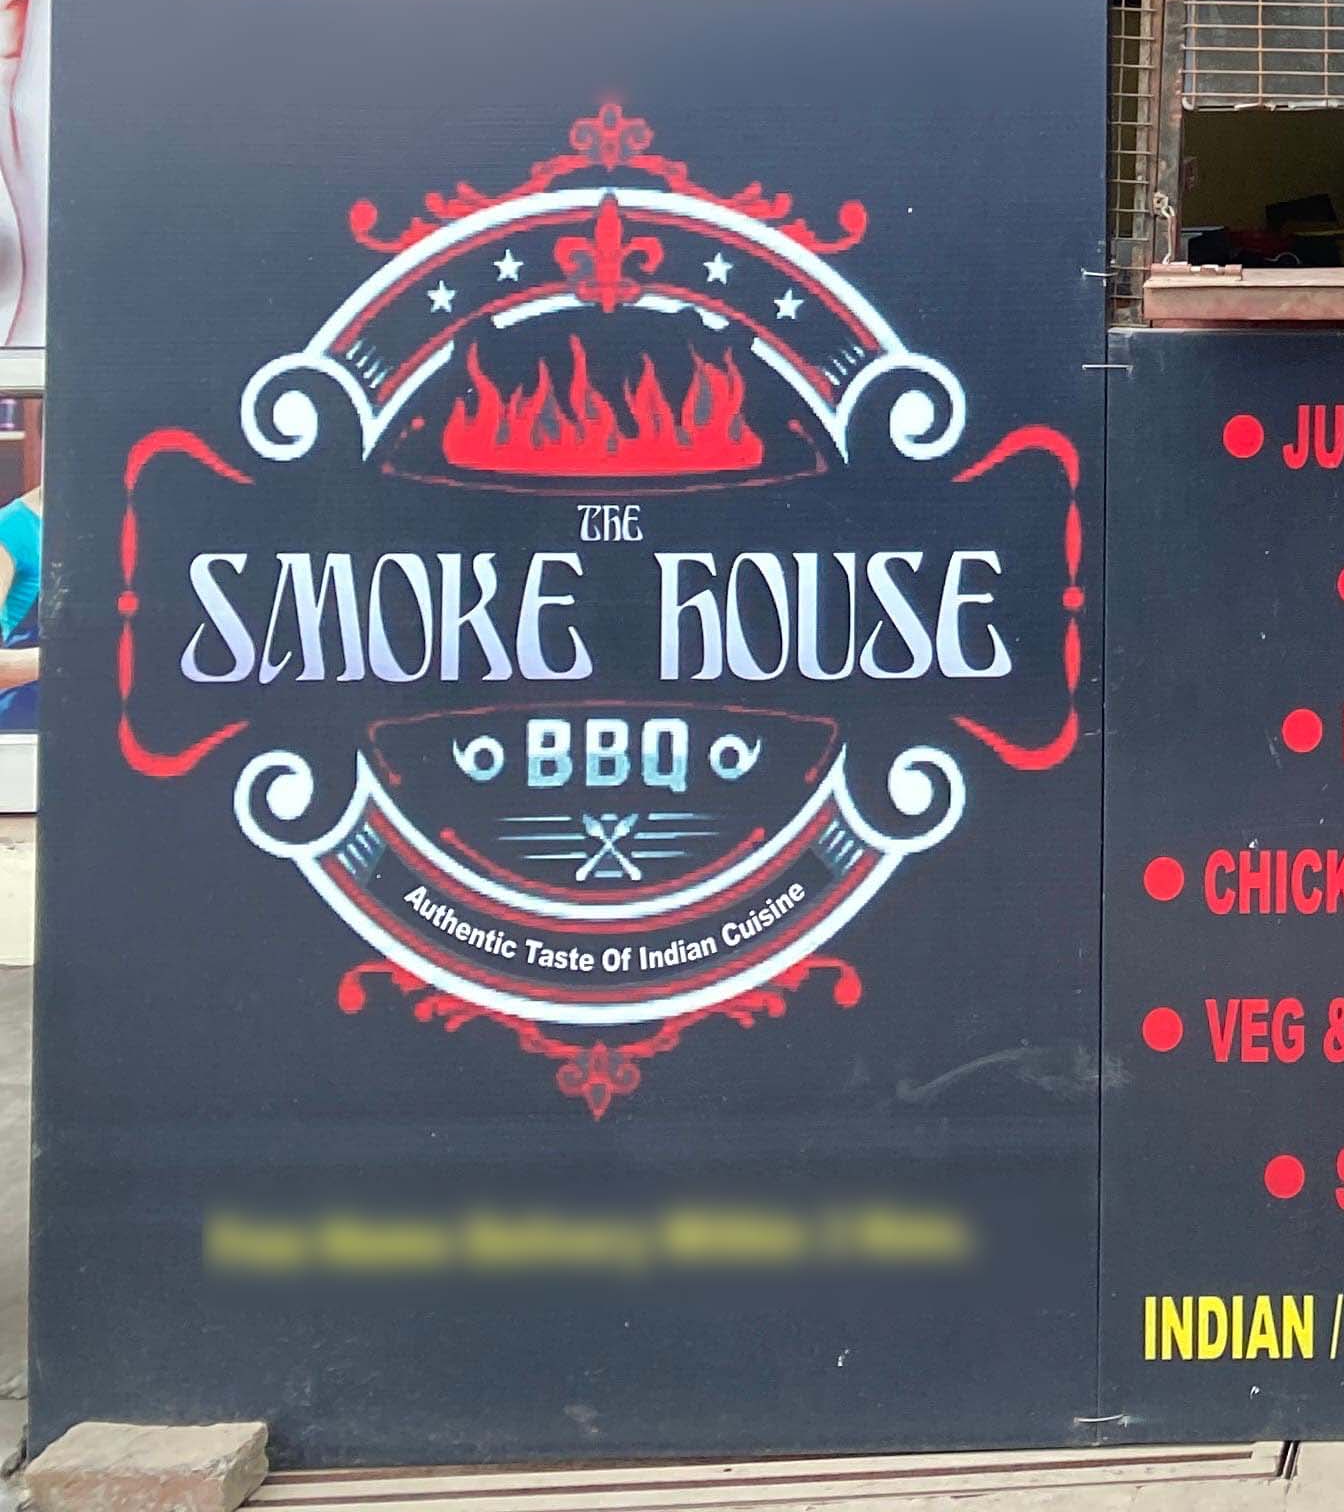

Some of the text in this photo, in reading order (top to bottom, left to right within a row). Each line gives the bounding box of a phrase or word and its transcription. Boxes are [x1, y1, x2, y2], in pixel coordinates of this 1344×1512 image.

[181, 551, 1012, 683] SMOKE HOUSE
[527, 719, 688, 792] BBQ
[403, 881, 807, 972] Authentic Taste Of Indian Cuisine
[1205, 997, 1305, 1063] VEG
[1145, 1295, 1313, 1360] INDIAN
